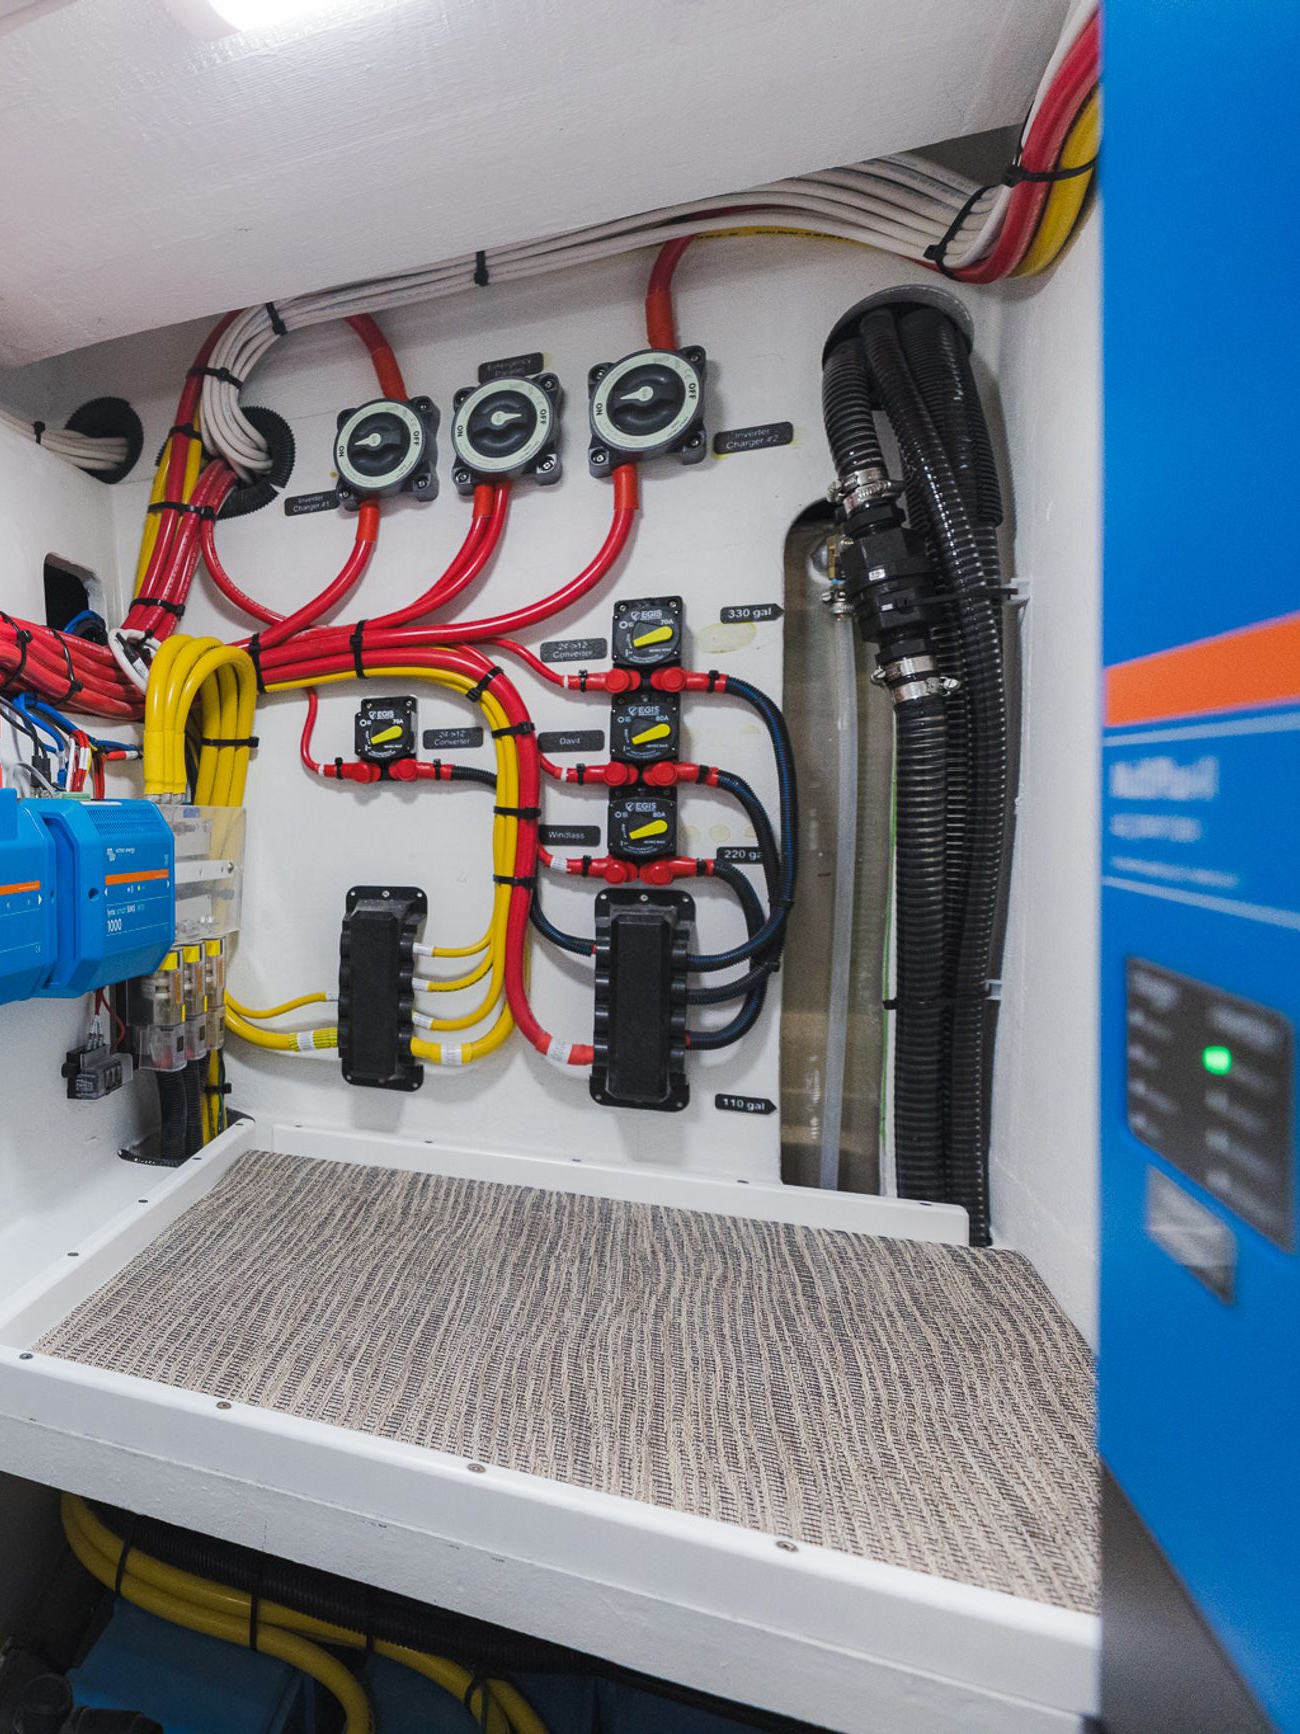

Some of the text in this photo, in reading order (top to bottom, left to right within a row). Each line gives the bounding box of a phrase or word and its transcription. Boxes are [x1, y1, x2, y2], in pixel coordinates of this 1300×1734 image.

[596, 403, 603, 416] ON
[457, 425, 463, 437] ON
[735, 429, 770, 438] Inverter
[726, 438, 764, 449] Charger
[339, 445, 345, 457] ON
[641, 610, 662, 618] EGIS
[728, 607, 772, 619] 330 gal
[552, 650, 593, 659] Converter
[638, 706, 660, 714] EGIS
[434, 738, 470, 746] Converter
[560, 737, 581, 745] Davit
[635, 802, 657, 810] EGIS
[548, 831, 585, 840] Windlass
[724, 849, 746, 859] 220
[107, 918, 122, 933] 1000
[723, 1098, 765, 1111] 110 gal
